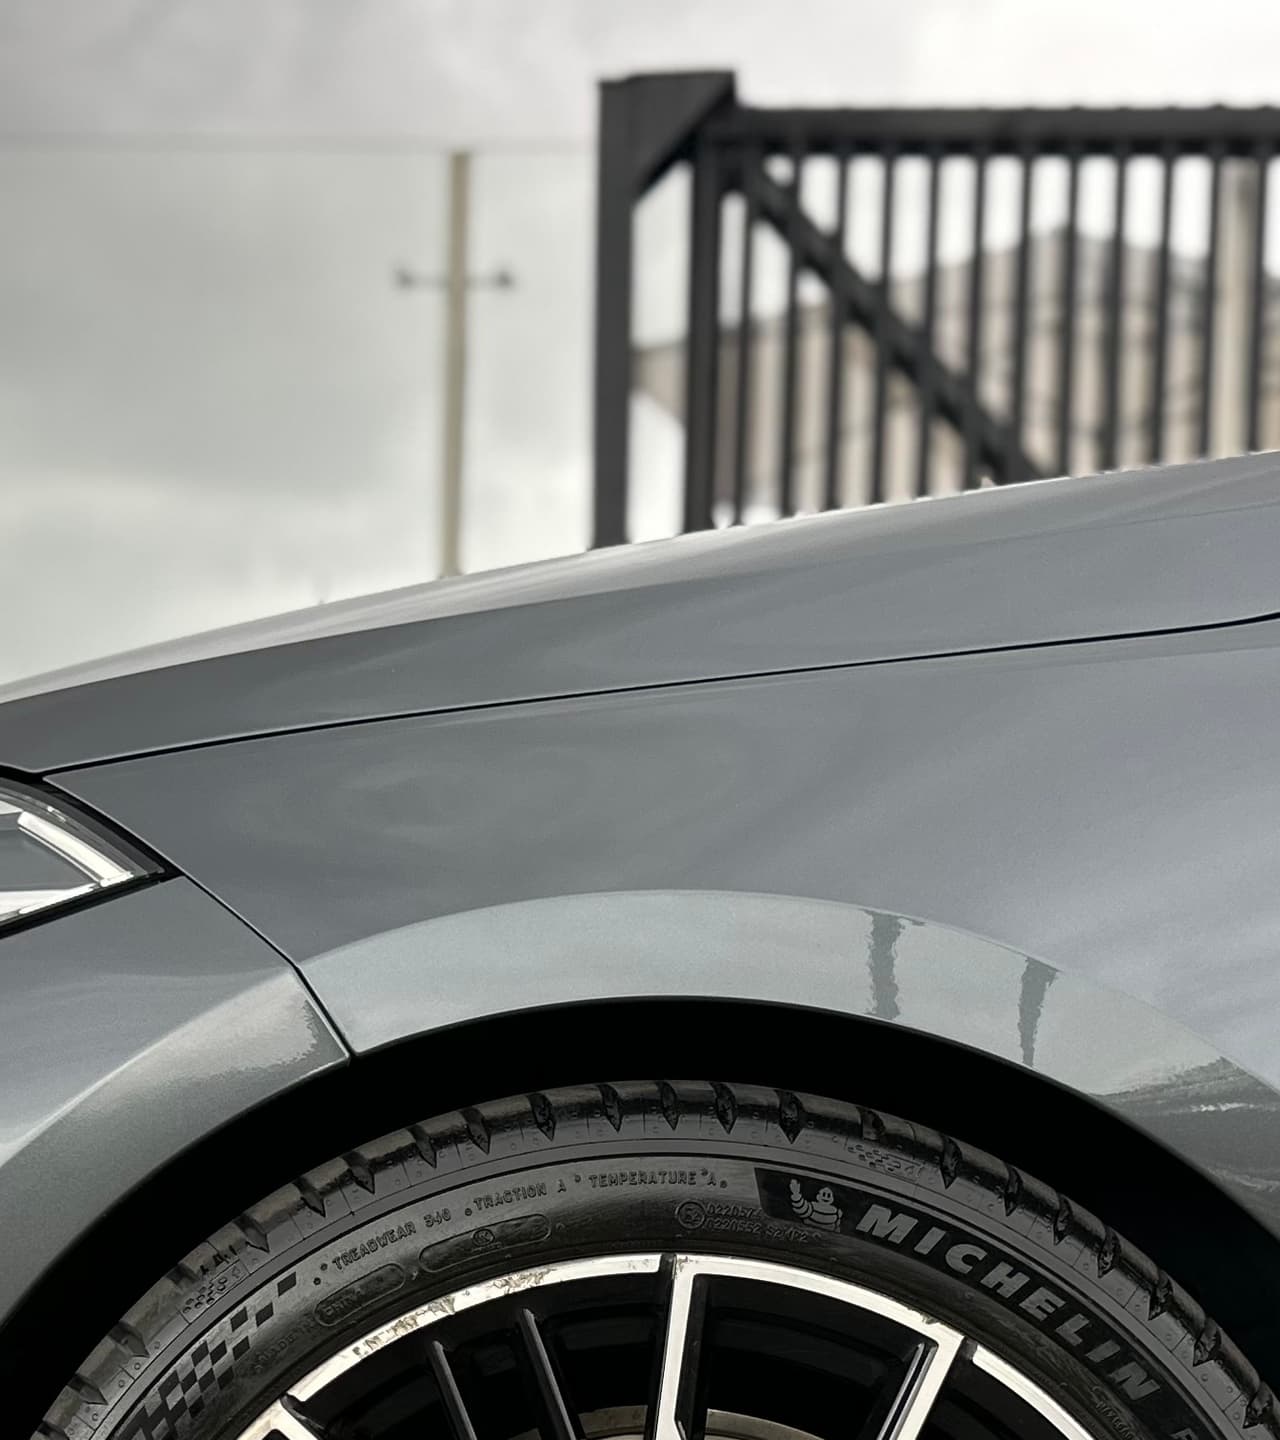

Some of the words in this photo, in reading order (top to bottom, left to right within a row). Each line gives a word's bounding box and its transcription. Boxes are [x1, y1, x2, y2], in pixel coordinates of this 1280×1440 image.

[332, 1220, 418, 1273] TREADWEAR
[473, 1181, 548, 1212] TRACTION
[555, 1178, 566, 1193] A
[587, 1170, 696, 1189] TEMPERATURE
[856, 1203, 1160, 1400] MICHELIN
